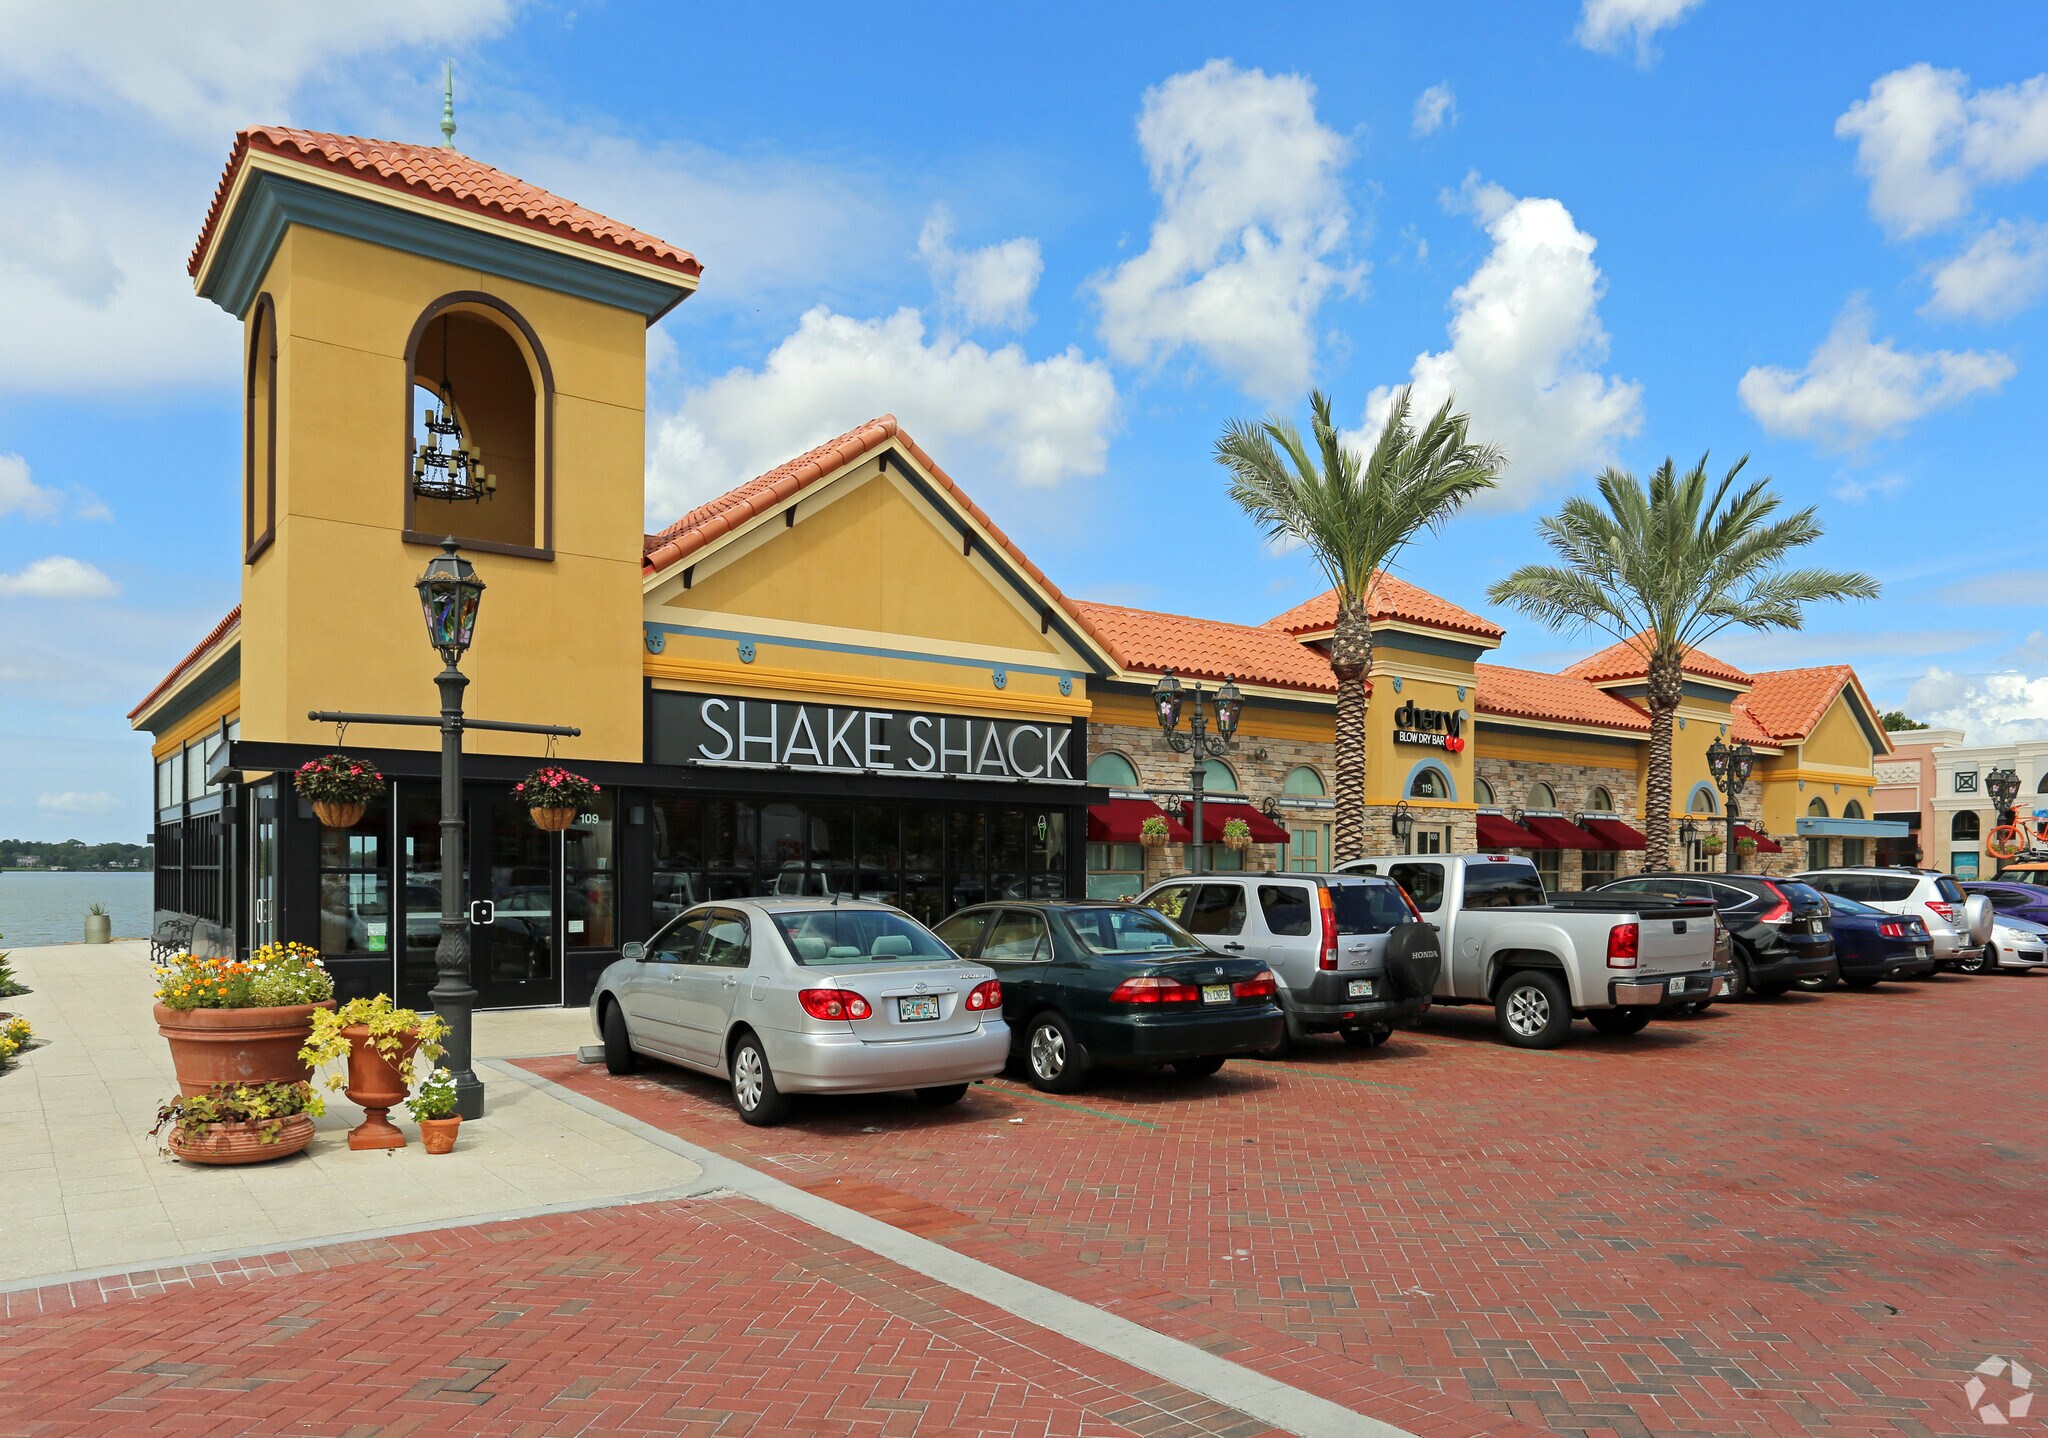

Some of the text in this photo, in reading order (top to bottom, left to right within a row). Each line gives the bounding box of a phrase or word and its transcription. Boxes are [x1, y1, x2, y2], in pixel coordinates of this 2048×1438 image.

[1394, 699, 1468, 738] cherry
[697, 698, 1075, 780] SHAKE SHACK
[1399, 731, 1445, 746] BLOW DRY BAR
[1421, 783, 1432, 794] 119
[580, 813, 599, 824] 109
[1412, 950, 1439, 959] HONDA
